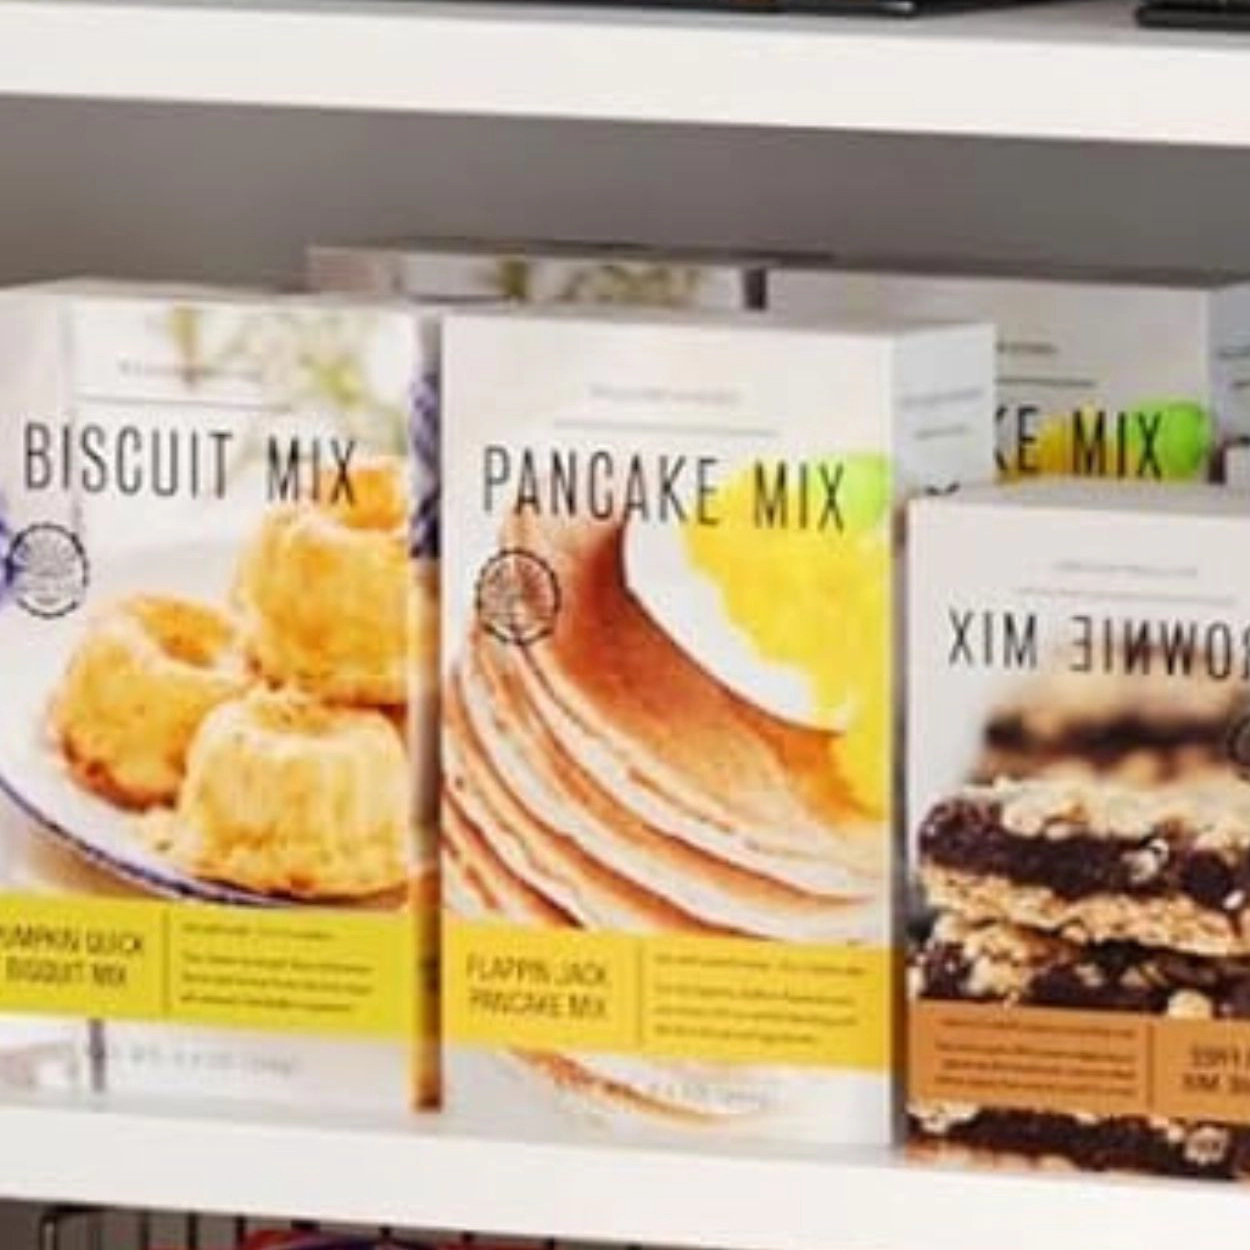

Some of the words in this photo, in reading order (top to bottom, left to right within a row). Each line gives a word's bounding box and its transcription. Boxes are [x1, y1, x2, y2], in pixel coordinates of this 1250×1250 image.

[23, 422, 234, 499] BISCUIT
[266, 434, 357, 506] MIX
[1071, 409, 1162, 480] MIX
[483, 444, 720, 526] PANCAKE
[752, 459, 846, 532] MIX
